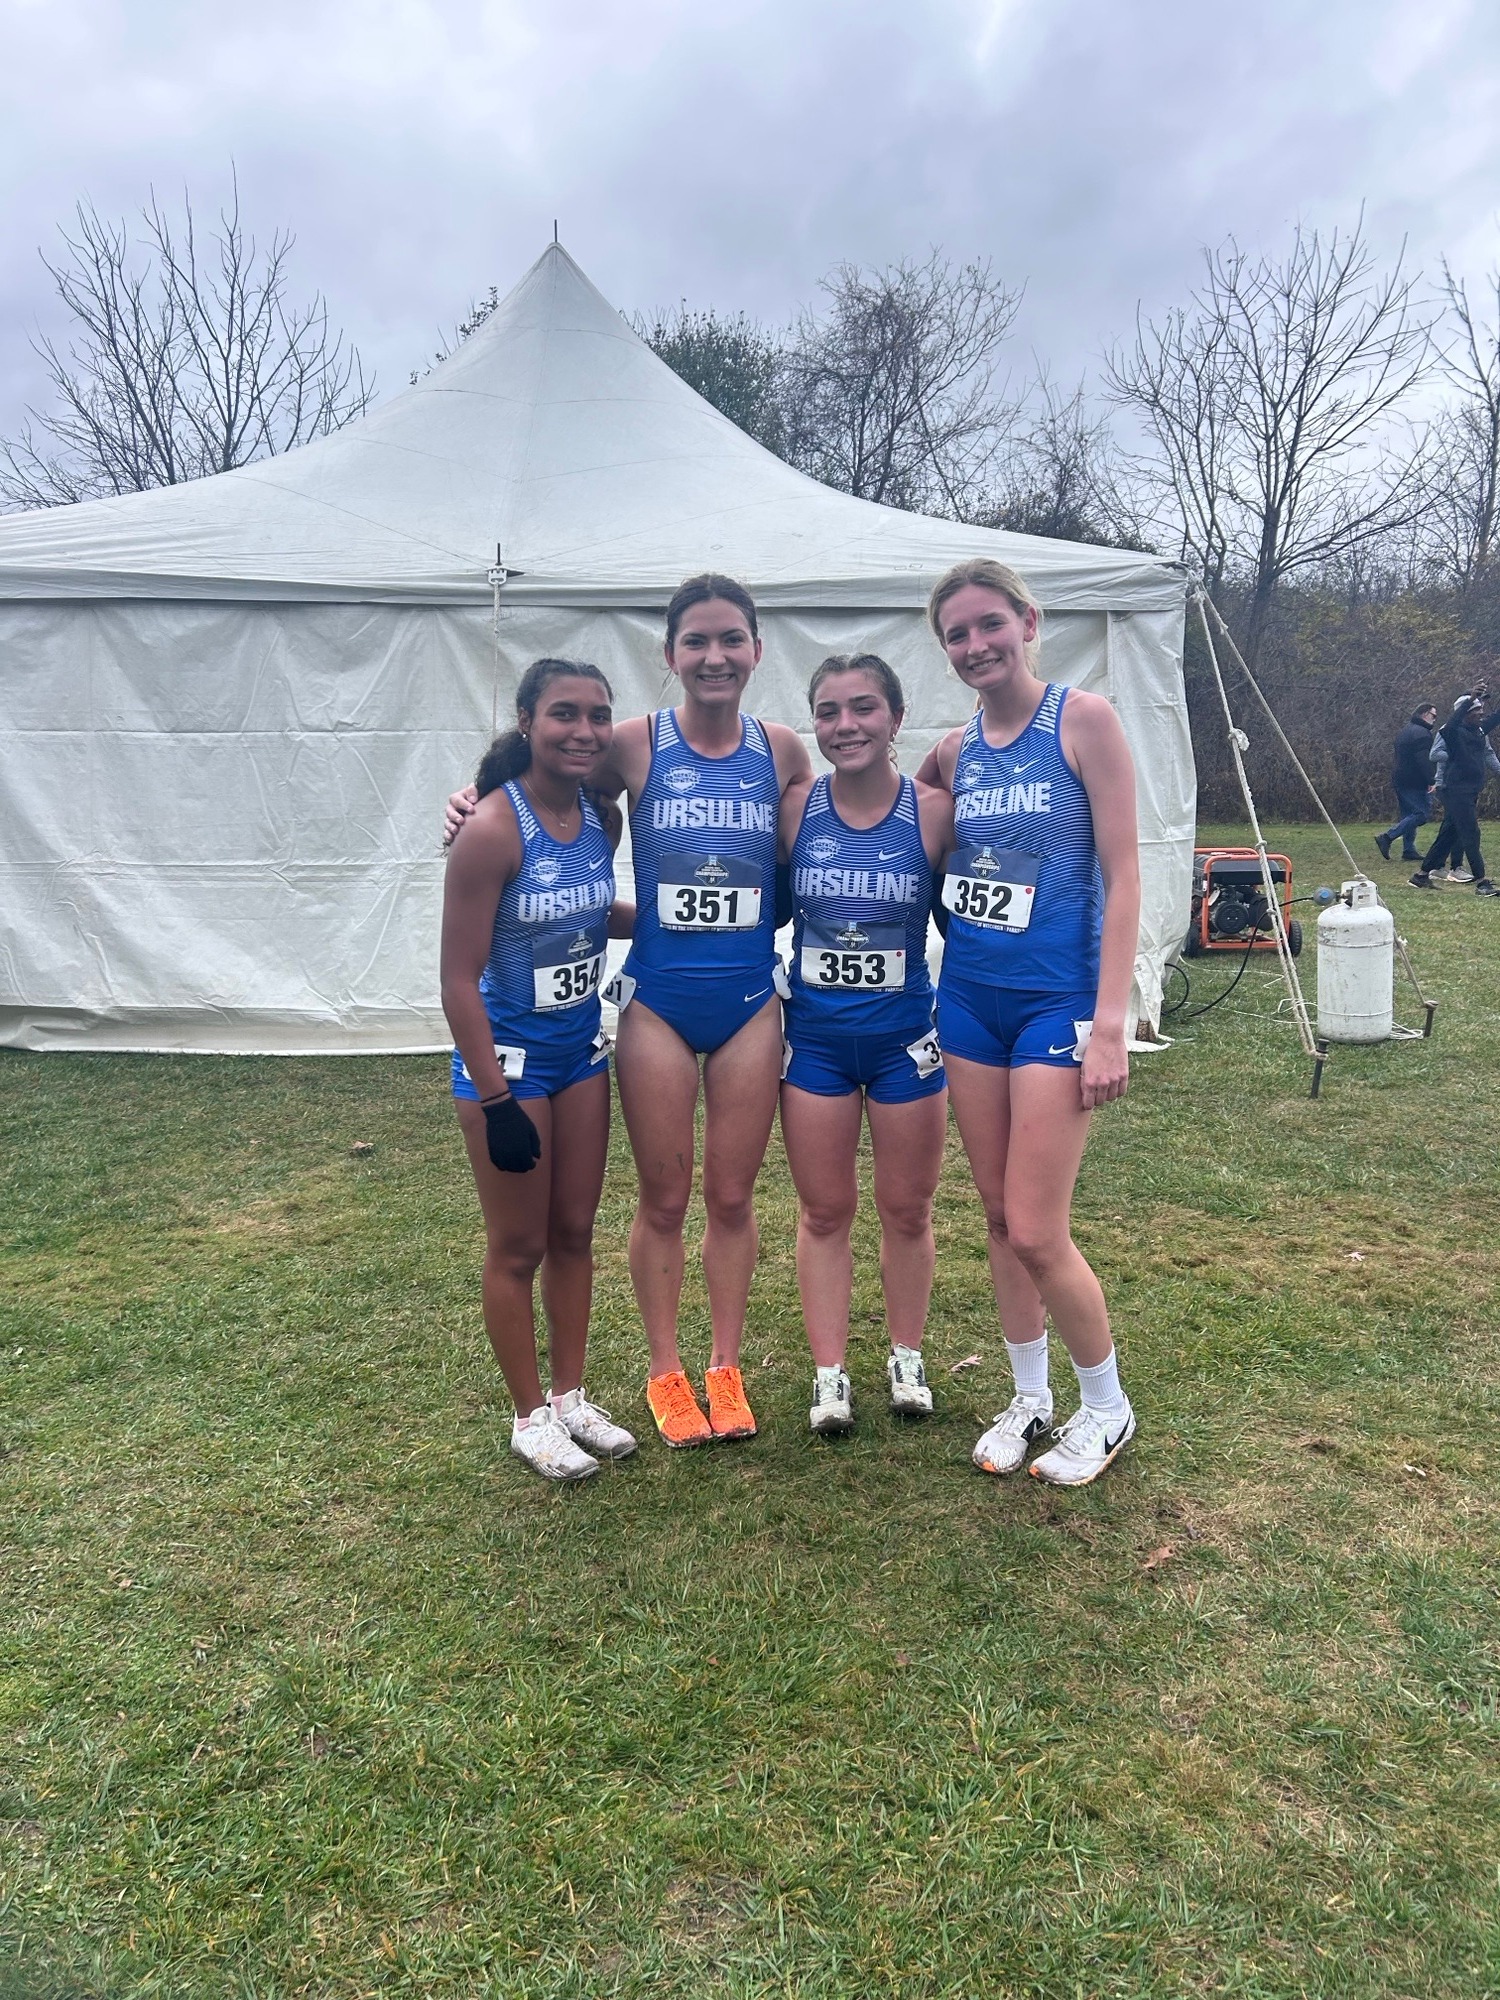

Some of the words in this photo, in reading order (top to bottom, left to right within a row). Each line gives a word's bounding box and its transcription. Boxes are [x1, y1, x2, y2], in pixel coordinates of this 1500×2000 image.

[653, 798, 773, 832] URSULINE
[518, 878, 615, 922] URSULIN
[795, 867, 919, 903] URSULINE
[954, 880, 1012, 921] 352
[675, 888, 738, 923] 351
[553, 957, 600, 1001] 354
[819, 952, 886, 985] 353
